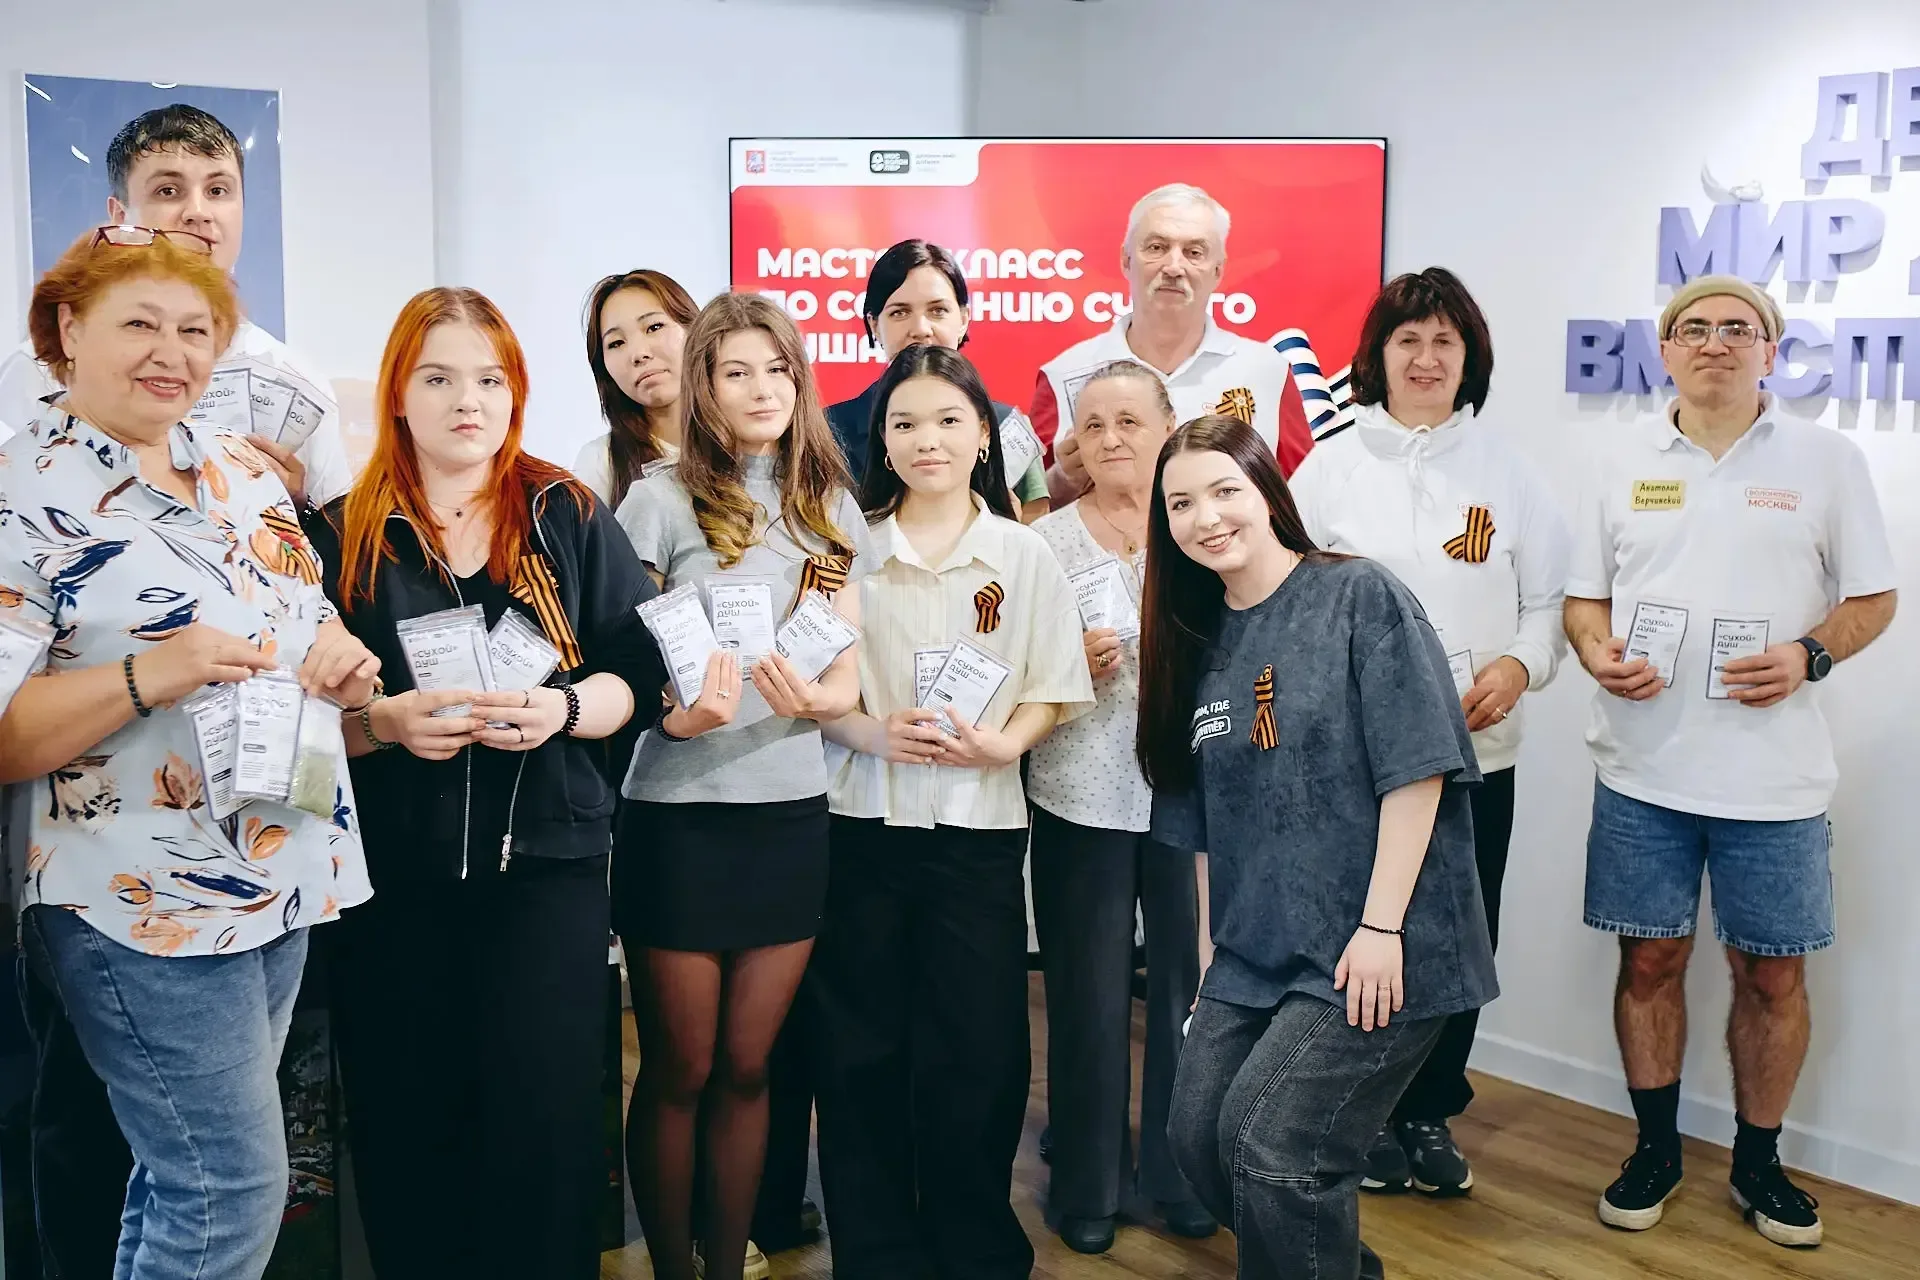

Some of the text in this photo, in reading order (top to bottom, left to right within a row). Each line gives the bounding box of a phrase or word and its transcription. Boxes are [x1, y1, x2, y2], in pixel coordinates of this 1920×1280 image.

[1658, 199, 1886, 286] МИР
[1565, 317, 1920, 401] ВМСТ
[1639, 482, 1680, 493] Анатолий
[1748, 499, 1797, 512] МОСКВЫ
[1078, 588, 1098, 601] ДУШ
[717, 608, 740, 618] ДУШ
[1636, 624, 1658, 634] ДУШ
[415, 657, 440, 669] ДУШ
[949, 663, 971, 680] ДУШ
[1210, 699, 1231, 714] ГДЕ
